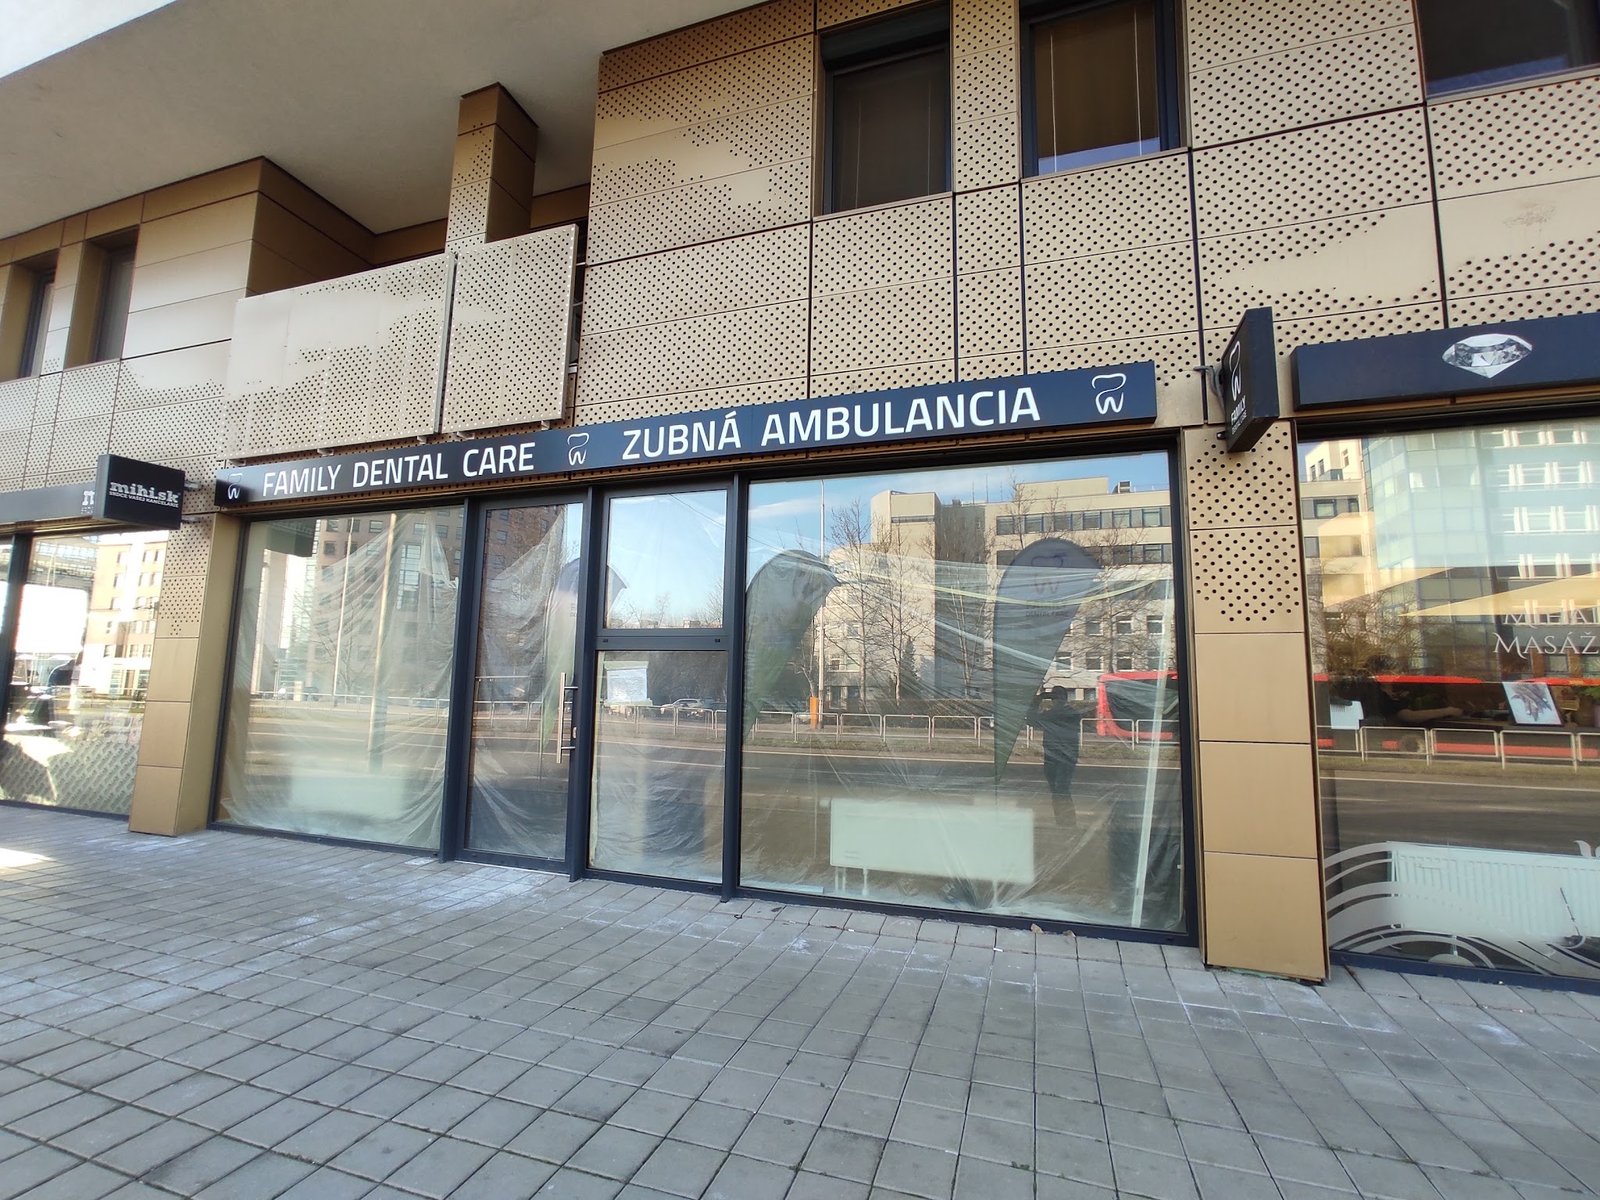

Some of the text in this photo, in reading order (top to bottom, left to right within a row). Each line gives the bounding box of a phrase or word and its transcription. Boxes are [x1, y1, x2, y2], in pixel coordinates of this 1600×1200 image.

[622, 387, 1041, 460] ZUBNÁ AMBULANCIA
[109, 482, 179, 503] mihi.sk
[263, 442, 536, 497] FAMILY DENTAL CARE
